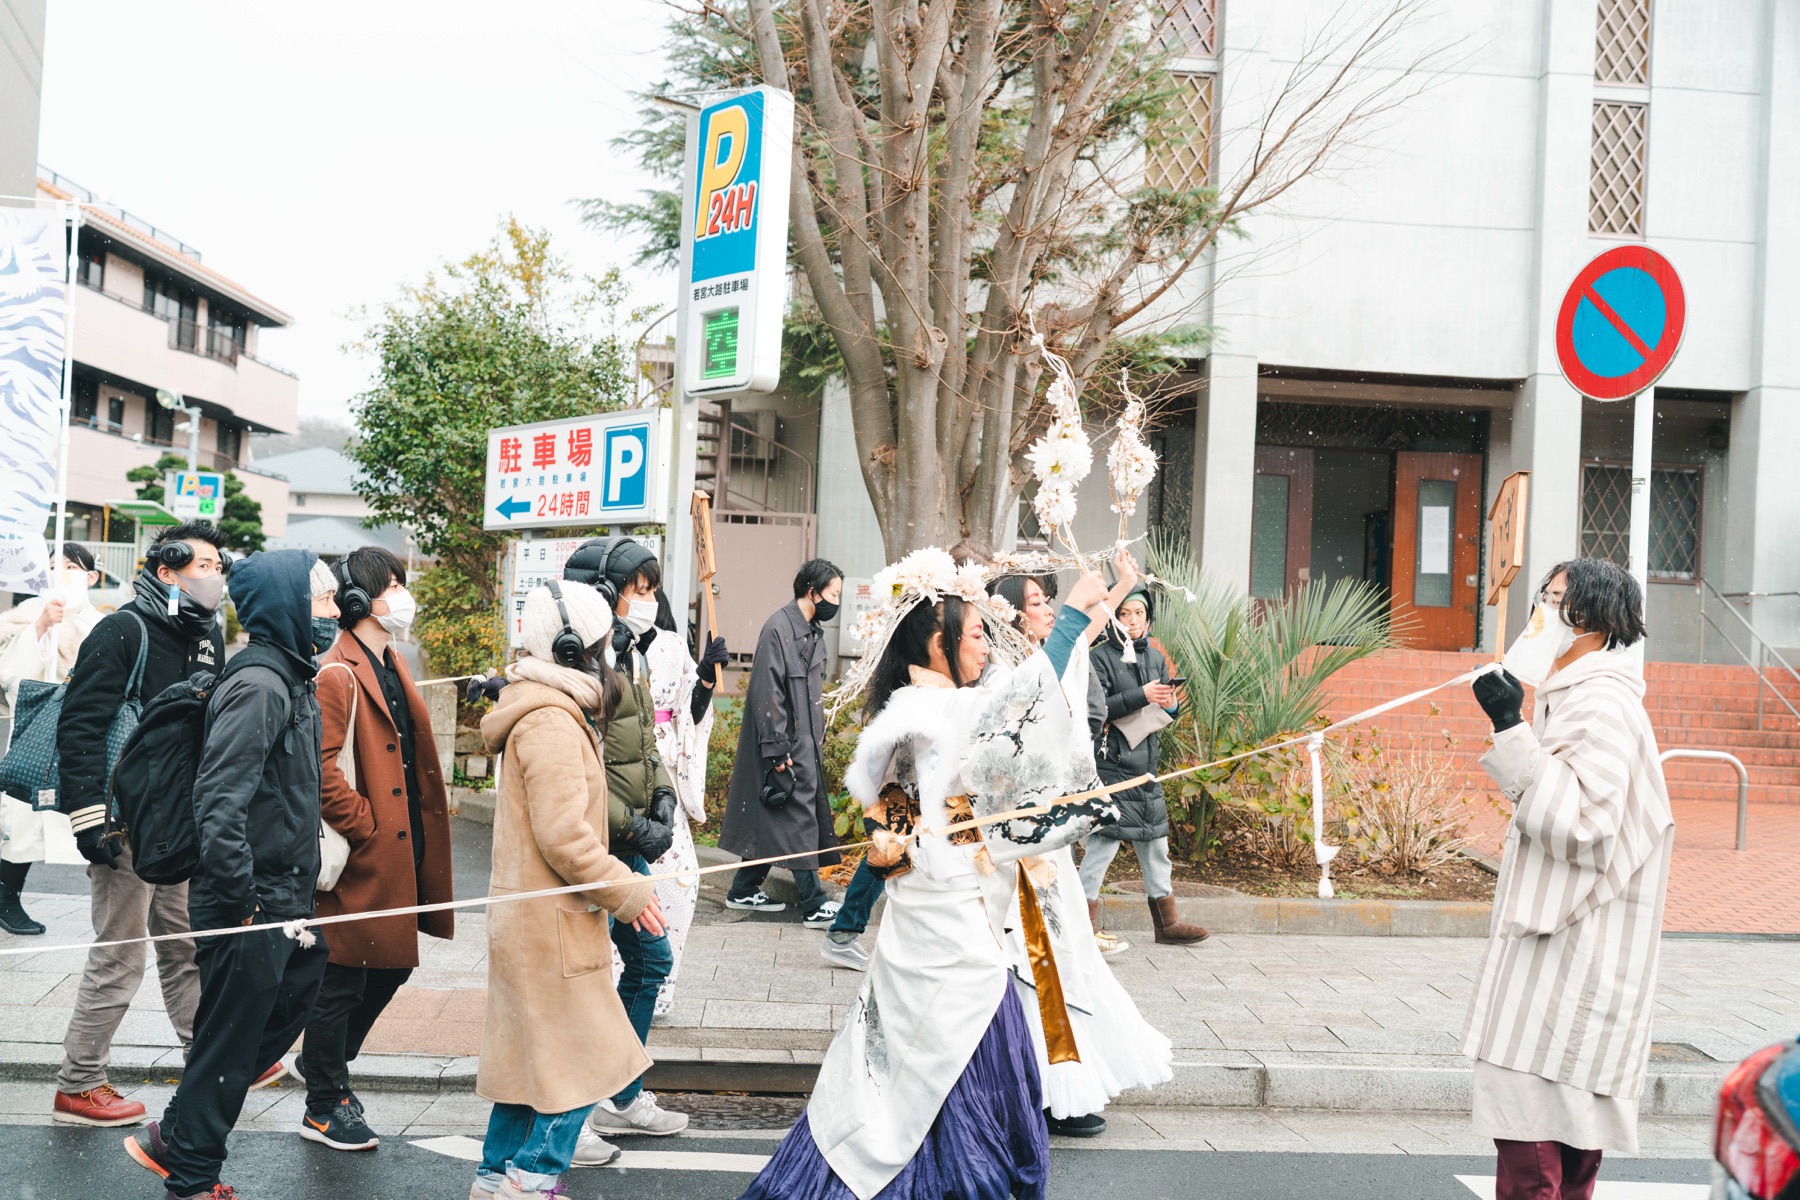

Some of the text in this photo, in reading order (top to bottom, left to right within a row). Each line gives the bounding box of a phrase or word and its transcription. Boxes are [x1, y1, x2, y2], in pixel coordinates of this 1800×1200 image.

[695, 107, 747, 239] P
[708, 182, 755, 236] 24H
[693, 278, 749, 301] 若宮大路駐車場
[498, 428, 593, 474] 駐車場
[608, 435, 644, 502] P
[182, 475, 199, 495] P
[500, 472, 587, 489] 若宮大路駐車場
[537, 491, 591, 517] 24時間
